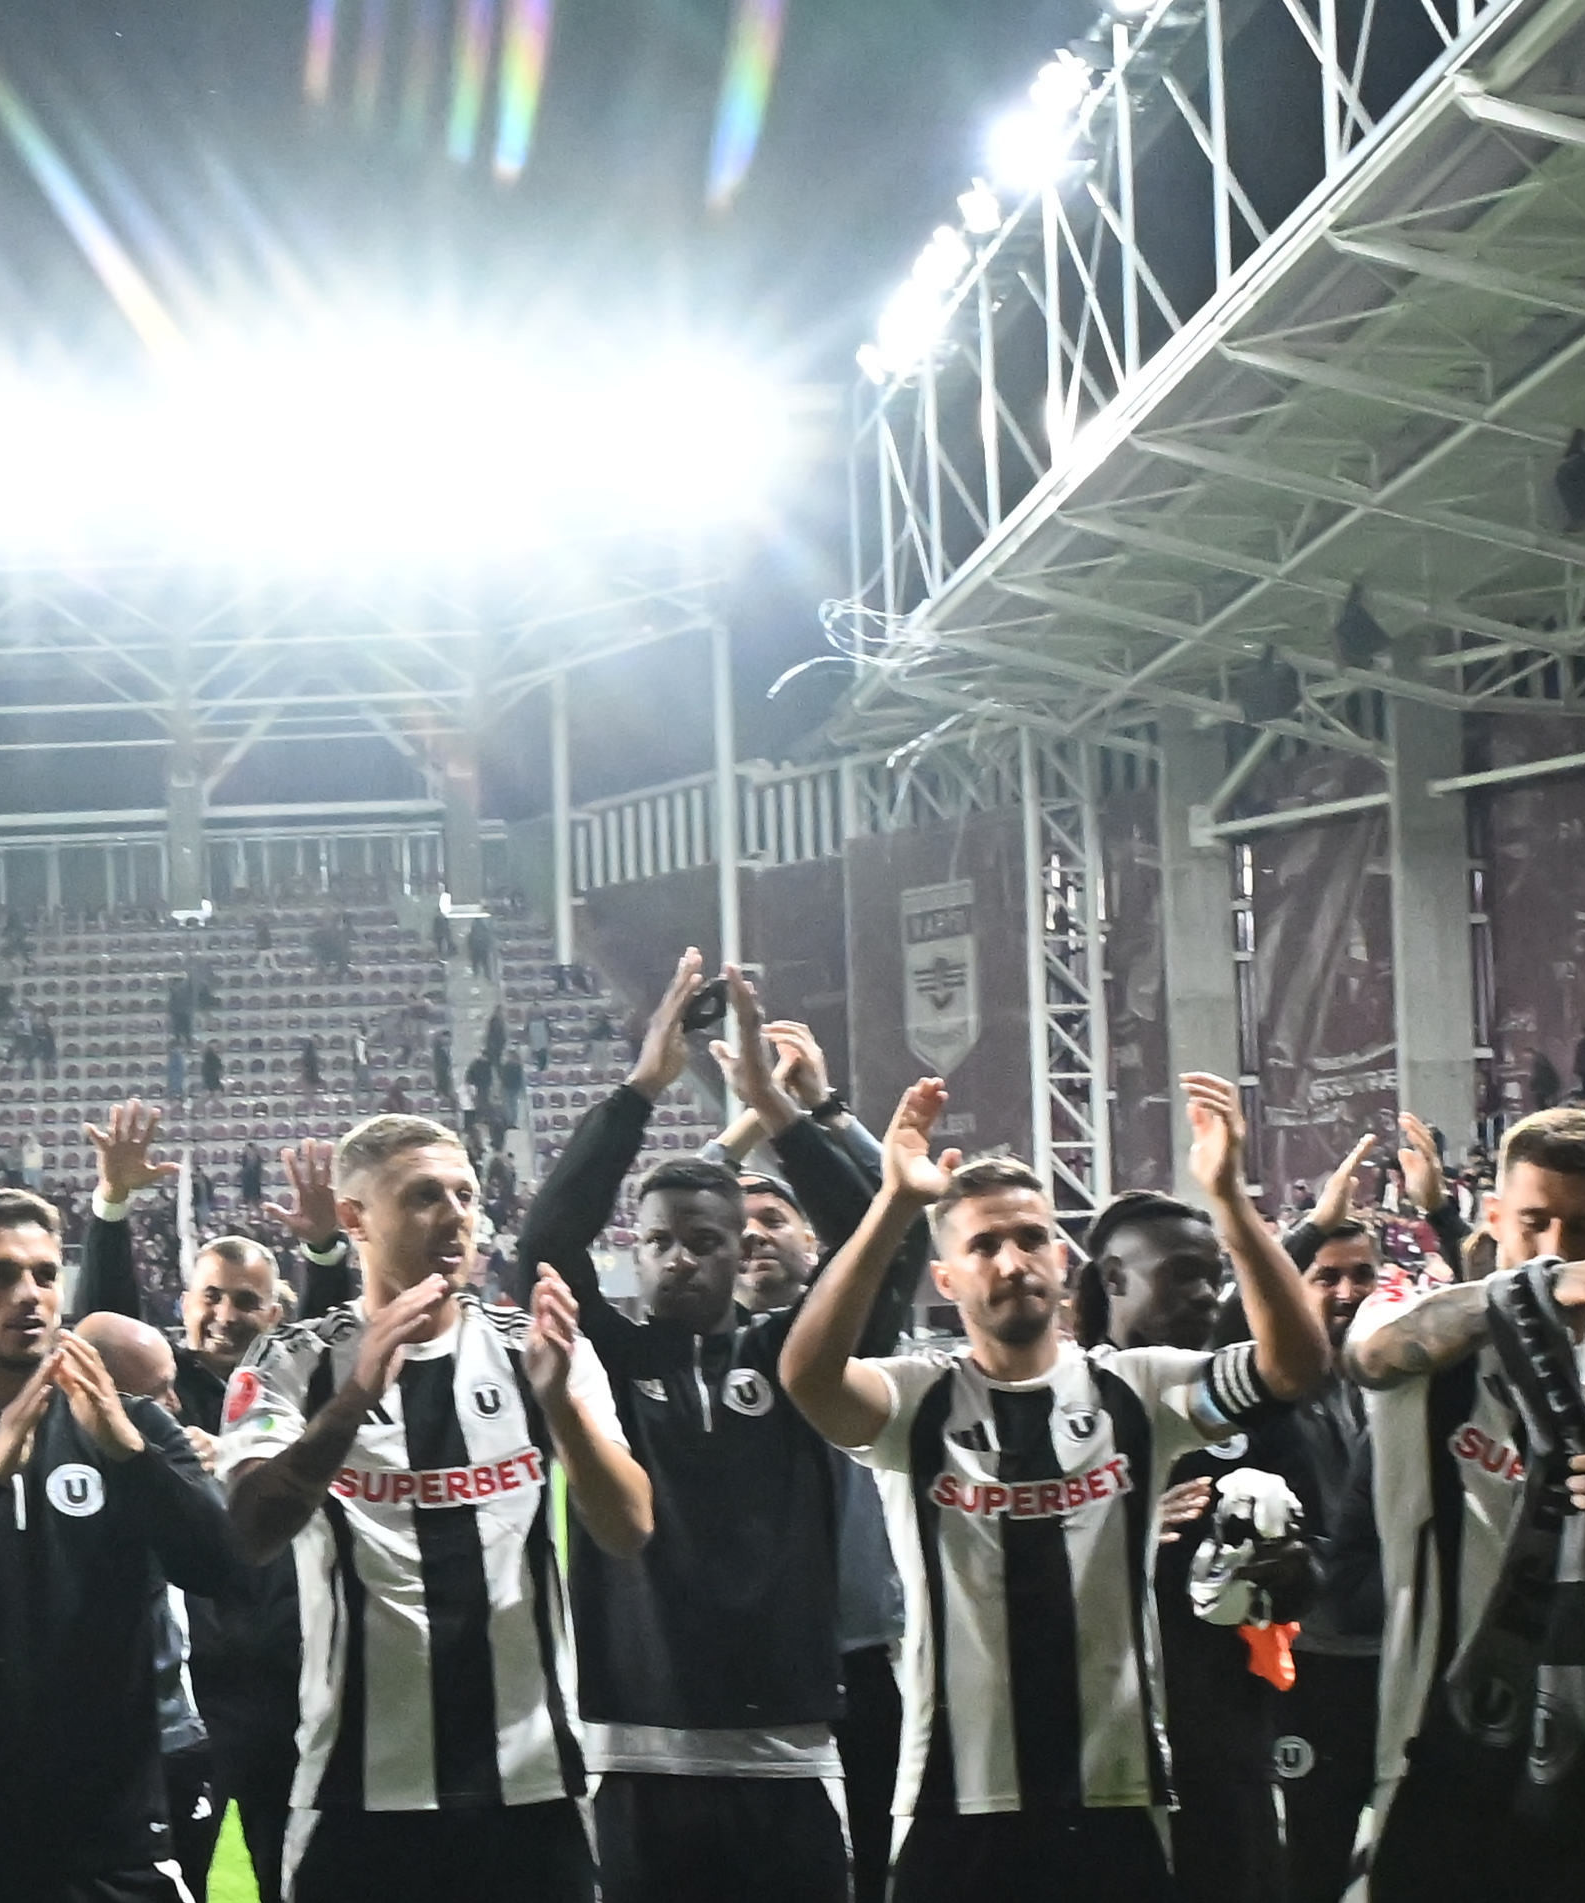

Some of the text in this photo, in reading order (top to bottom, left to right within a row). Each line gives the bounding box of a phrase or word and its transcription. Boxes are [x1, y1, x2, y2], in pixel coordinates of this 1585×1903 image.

[475, 1389, 502, 1415] U
[734, 1380, 759, 1406] U
[1068, 1416, 1096, 1439] U
[330, 1452, 539, 1504] SUPERBET
[932, 1459, 1127, 1516] SUPERBET
[64, 1478, 88, 1505] U
